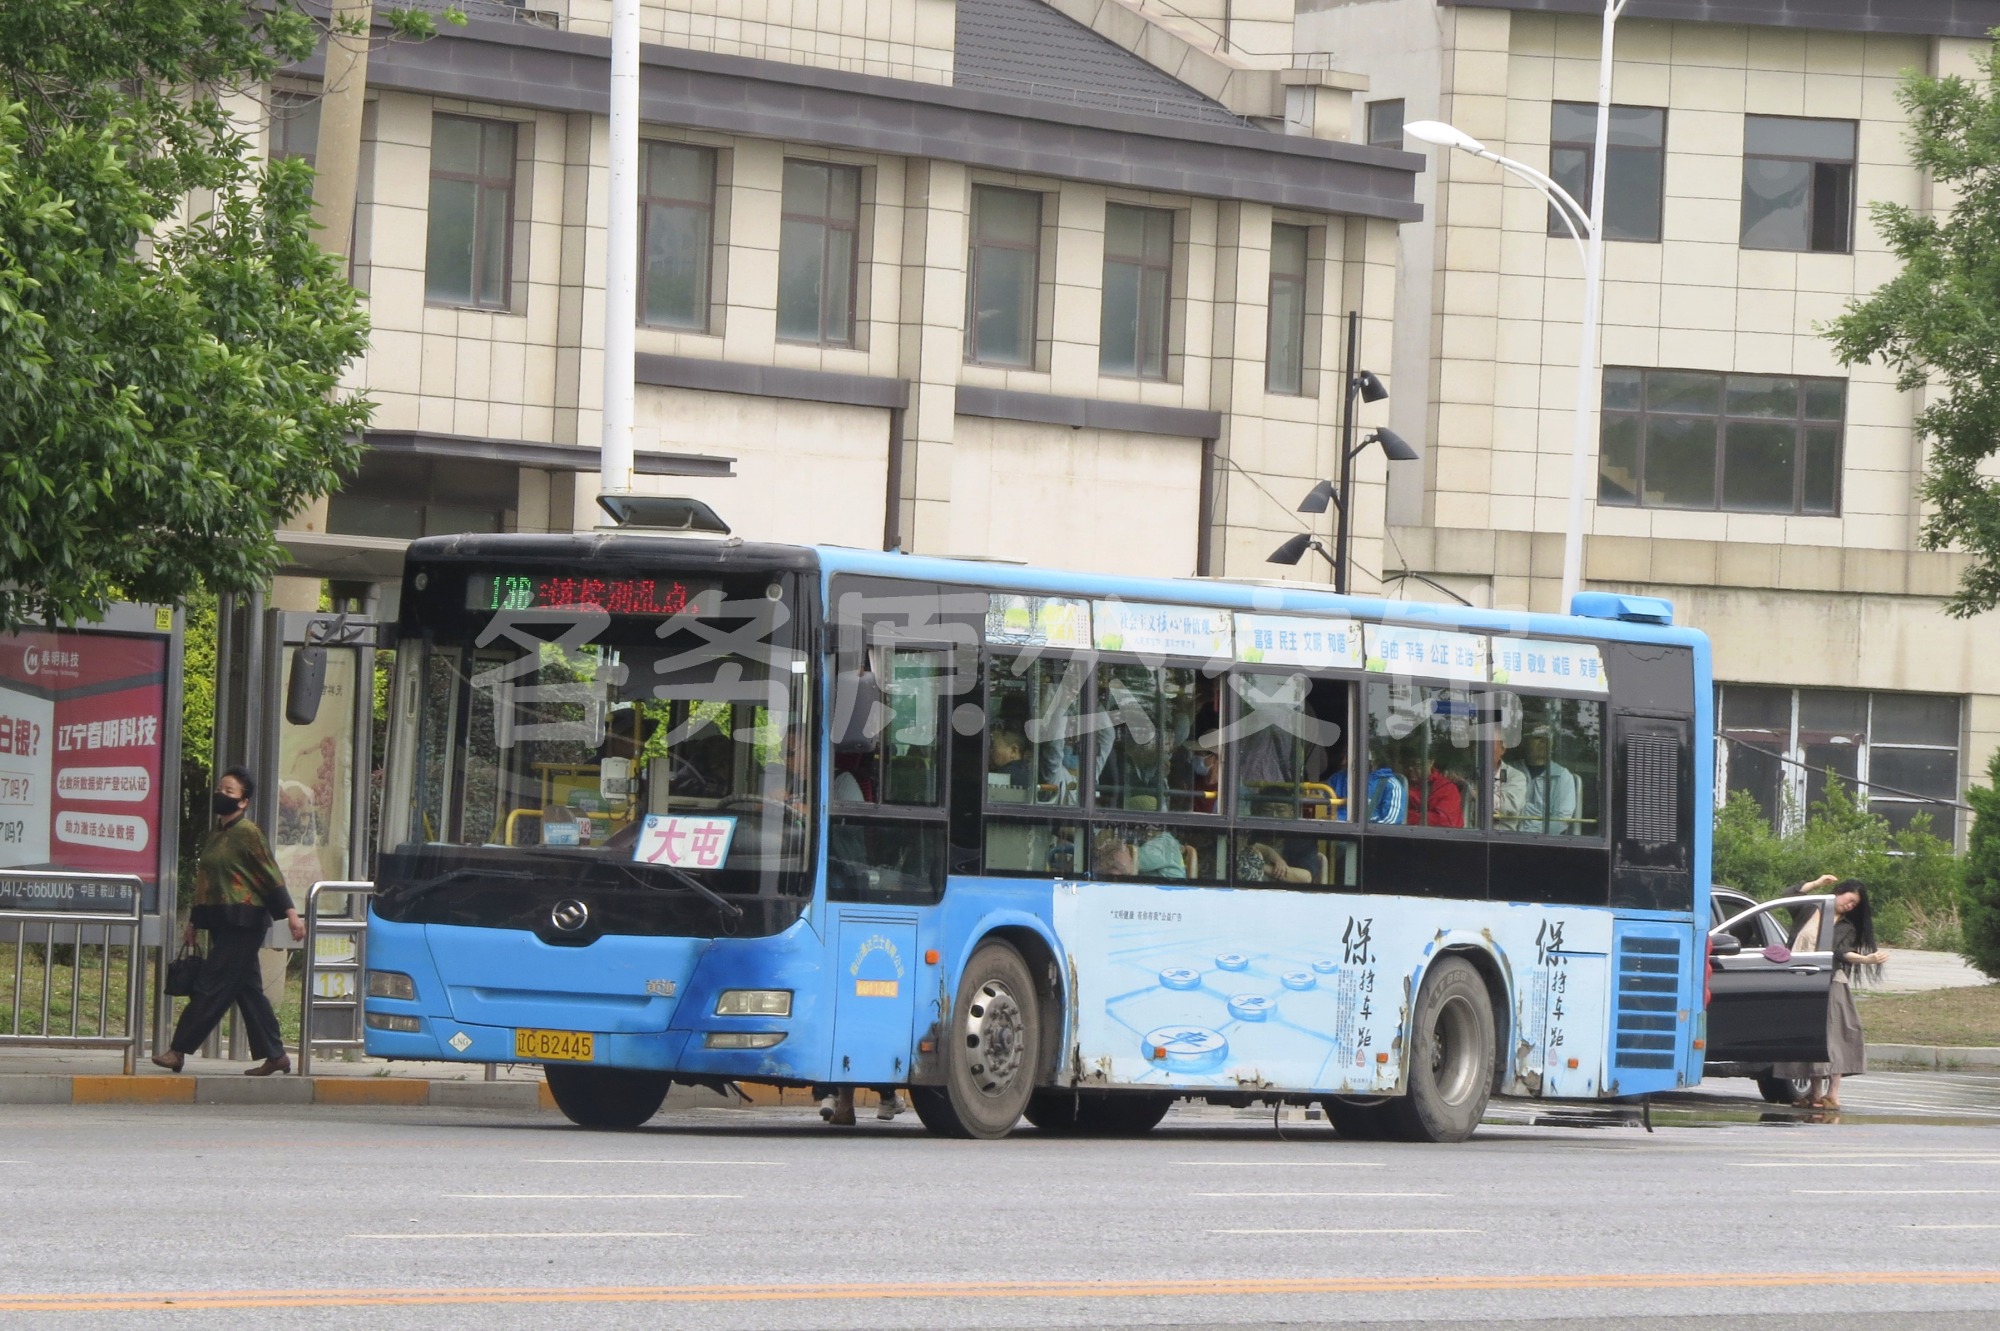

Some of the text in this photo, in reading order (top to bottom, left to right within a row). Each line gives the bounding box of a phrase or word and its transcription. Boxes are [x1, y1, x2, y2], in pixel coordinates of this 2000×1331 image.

[1254, 629, 1346, 653] 富强 民主 文明 和谐
[1380, 640, 1473, 667] 自由 平等 公正 法治
[41, 650, 79, 668] 春明科技
[1503, 652, 1598, 678] 爱国 敬业 诚信 友善
[58, 715, 158, 751] 辽宁春明科技
[65, 819, 135, 842] 助力激活企业数据
[646, 819, 725, 867] 大屯
[1342, 915, 1376, 1048] 保持车距
[1535, 918, 1568, 1048] 保持车距
[452, 1037, 469, 1047] LNG
